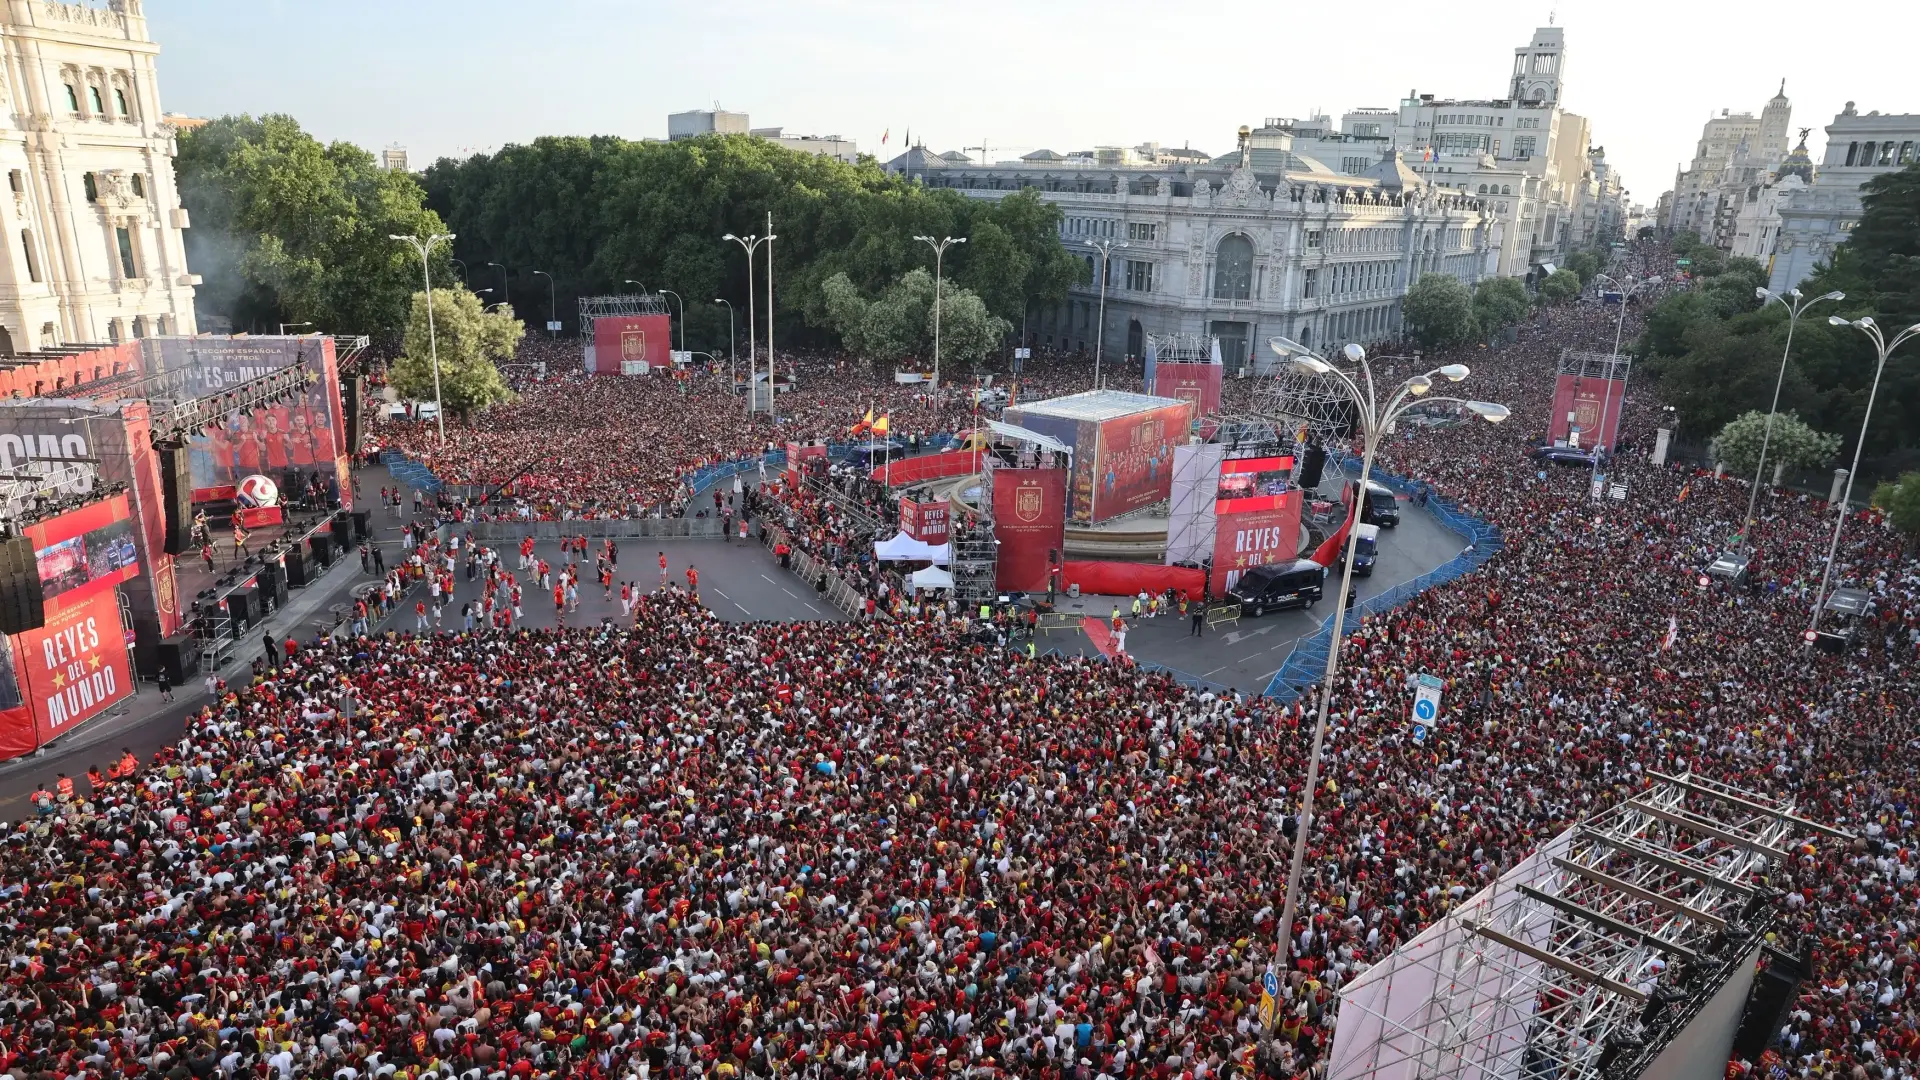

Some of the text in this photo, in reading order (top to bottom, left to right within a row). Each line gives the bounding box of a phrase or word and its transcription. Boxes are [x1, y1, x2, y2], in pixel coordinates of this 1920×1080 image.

[224, 371, 238, 382] DEL
[924, 510, 944, 520] REYES
[921, 524, 946, 535] MUNDO
[1235, 526, 1280, 553] REYES
[1248, 553, 1262, 566] DEL
[42, 616, 99, 670] REYES
[67, 659, 86, 681] DEL
[47, 665, 116, 729] MUNDO
[172, 820, 188, 830] 88
[416, 1040, 425, 1053] 12
